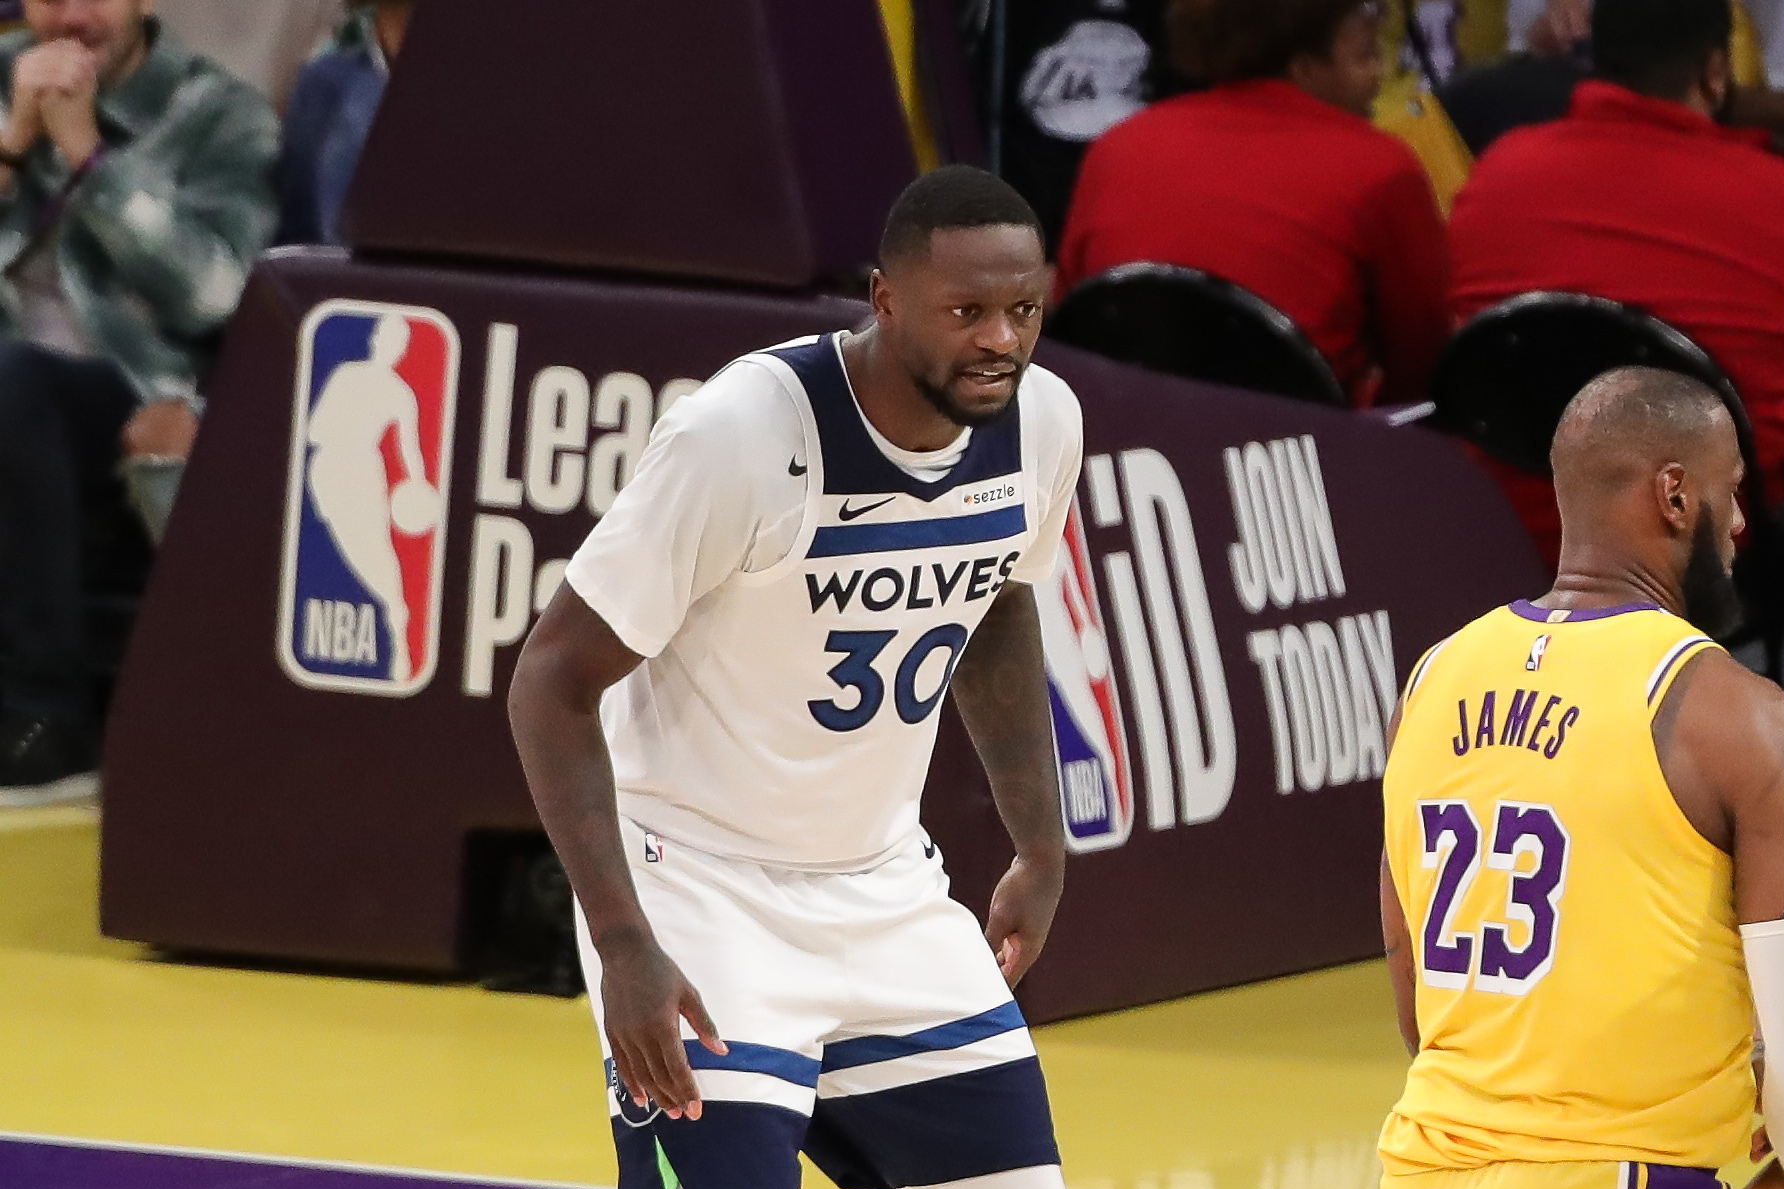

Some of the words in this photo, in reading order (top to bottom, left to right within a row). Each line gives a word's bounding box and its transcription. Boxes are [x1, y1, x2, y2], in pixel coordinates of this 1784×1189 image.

[476, 322, 705, 516] Lea
[972, 483, 1015, 505] sezzle
[1222, 433, 1346, 614] JOIN
[307, 597, 378, 665] NBA
[804, 551, 1021, 614] WOLVES
[807, 622, 968, 732] 30
[1246, 609, 1398, 795] TODAY
[1452, 687, 1580, 760] JAMES
[1417, 799, 1571, 996] 23
